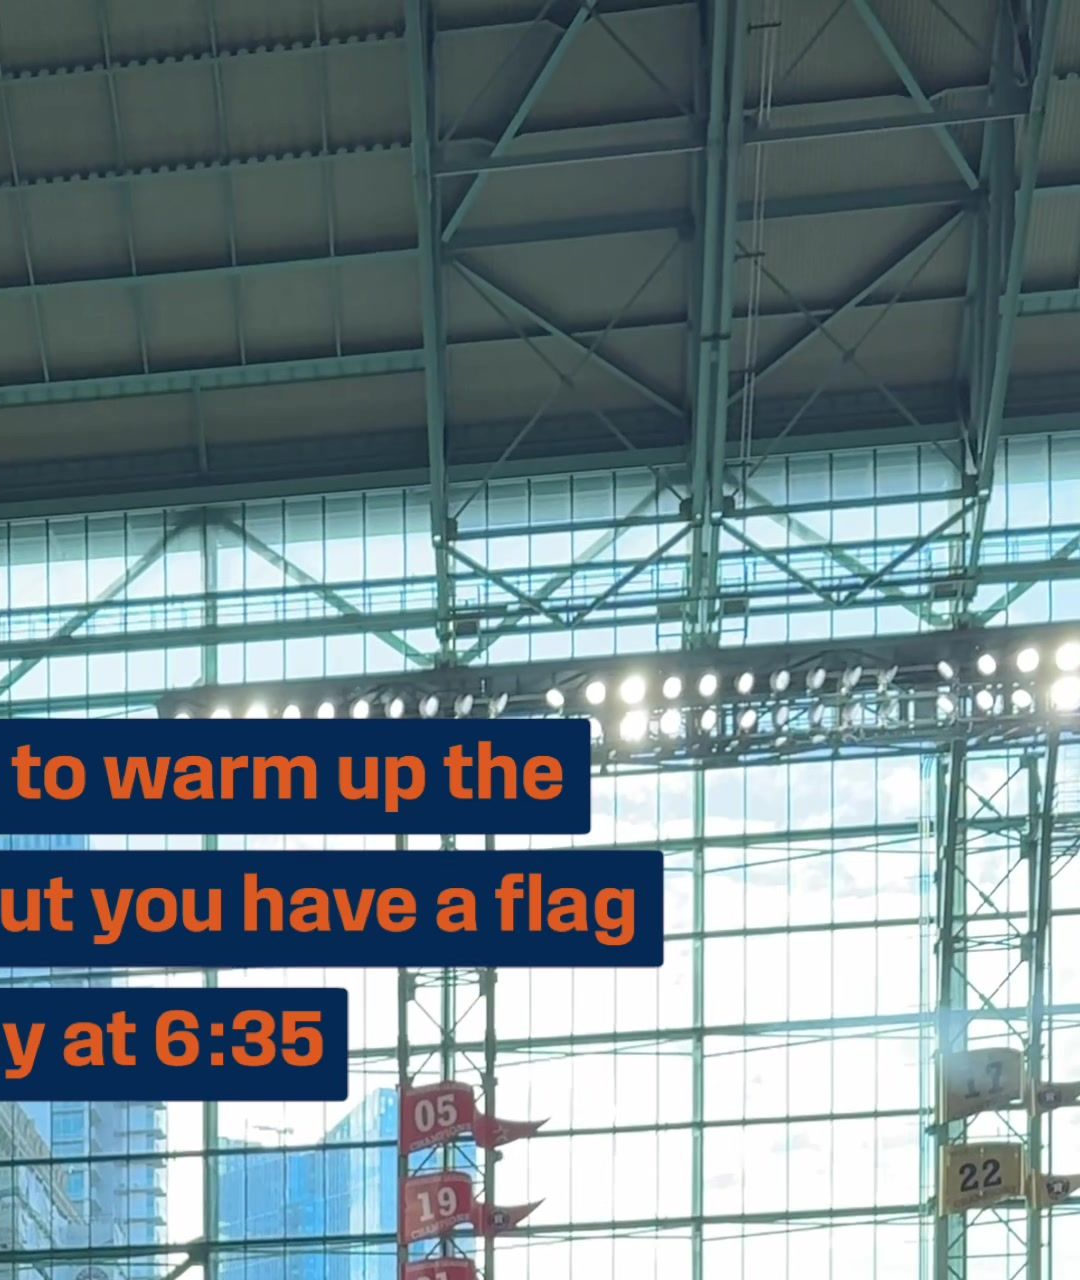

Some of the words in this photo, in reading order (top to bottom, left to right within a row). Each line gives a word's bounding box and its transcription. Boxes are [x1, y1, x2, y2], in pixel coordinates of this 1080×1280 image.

[415, 1094, 458, 1132] 05
[959, 1158, 1002, 1193] 22
[417, 1187, 457, 1222] 19
